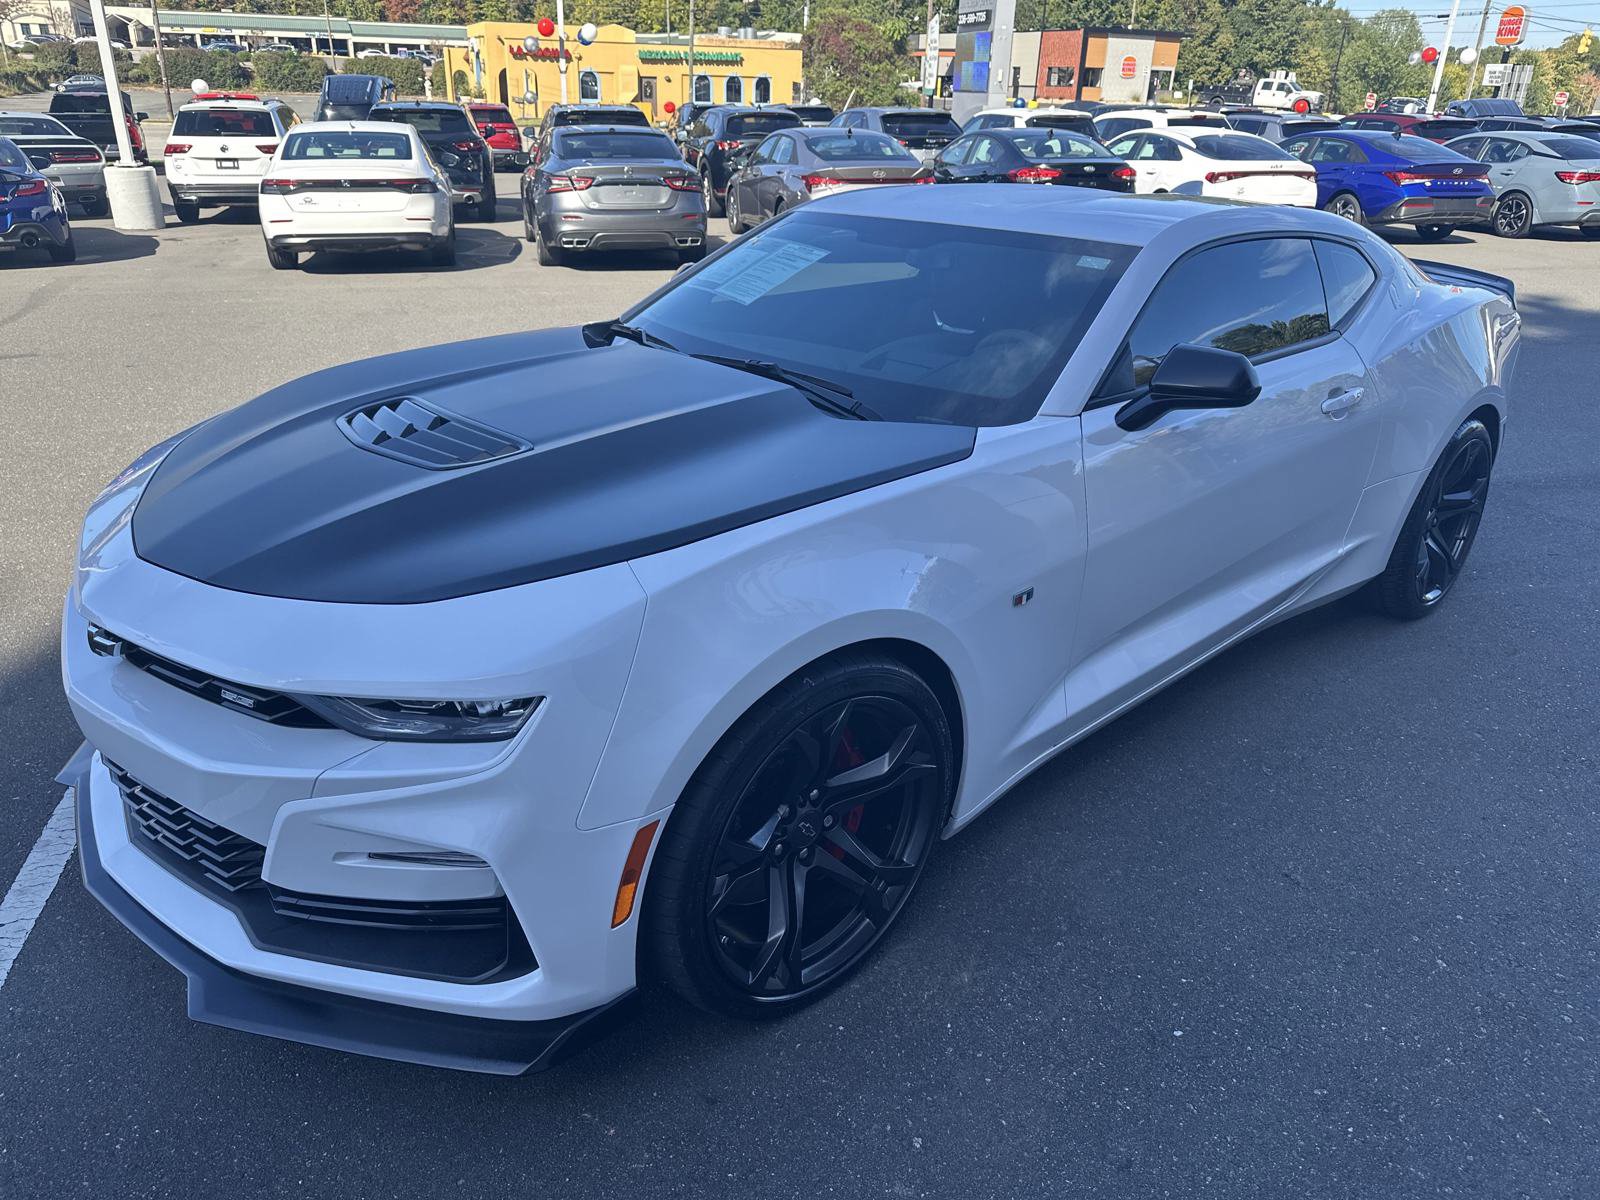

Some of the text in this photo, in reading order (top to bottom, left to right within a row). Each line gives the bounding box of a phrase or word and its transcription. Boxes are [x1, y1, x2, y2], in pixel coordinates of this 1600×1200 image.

[1500, 17, 1524, 26] BURGER
[1496, 26, 1521, 37] KING
[638, 50, 743, 61] MEXICAN RSTAURANT
